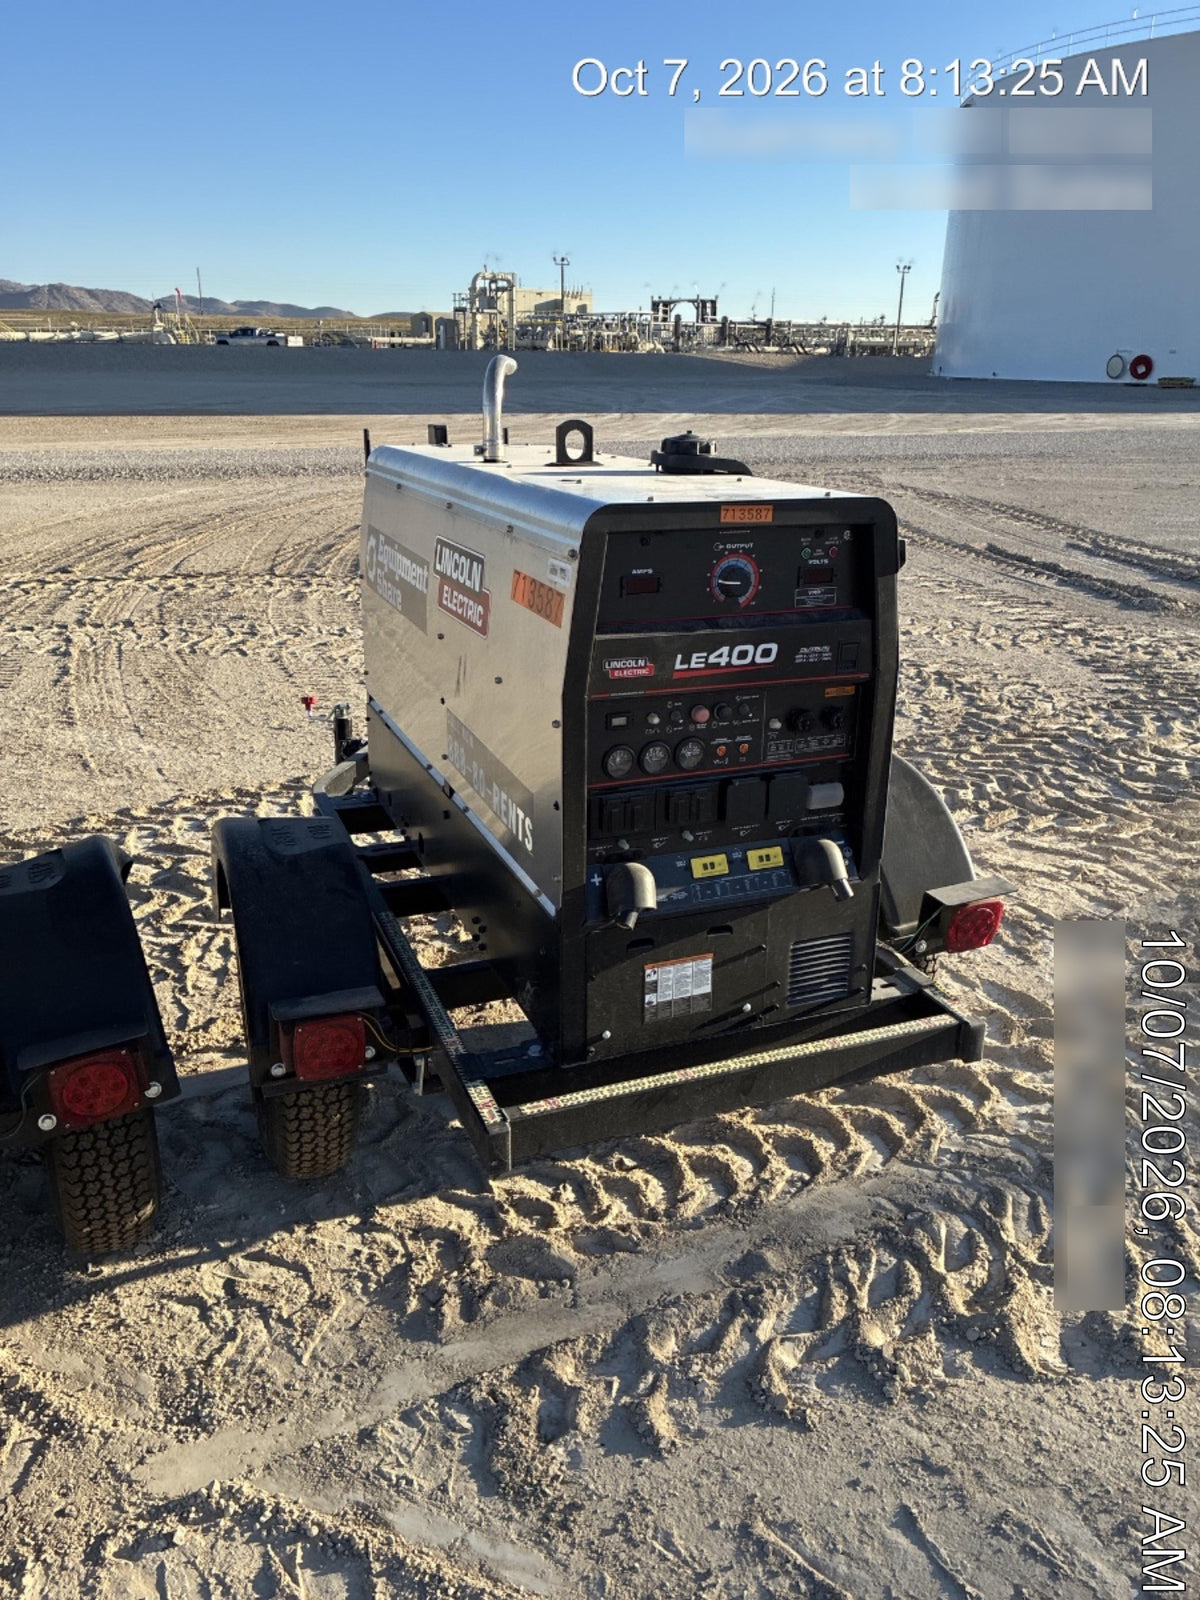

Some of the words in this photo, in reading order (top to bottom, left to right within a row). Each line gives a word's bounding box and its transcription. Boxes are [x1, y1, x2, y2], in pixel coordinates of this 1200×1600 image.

[722, 507, 770, 521] 713587
[378, 534, 428, 595] Equipment
[435, 544, 483, 592] LINCOLN
[442, 584, 484, 627] ELECTRIC
[513, 569, 565, 621] 713587
[604, 659, 645, 669] LINCOLN
[614, 667, 650, 677] ELECTRIC
[674, 642, 778, 670] LE400
